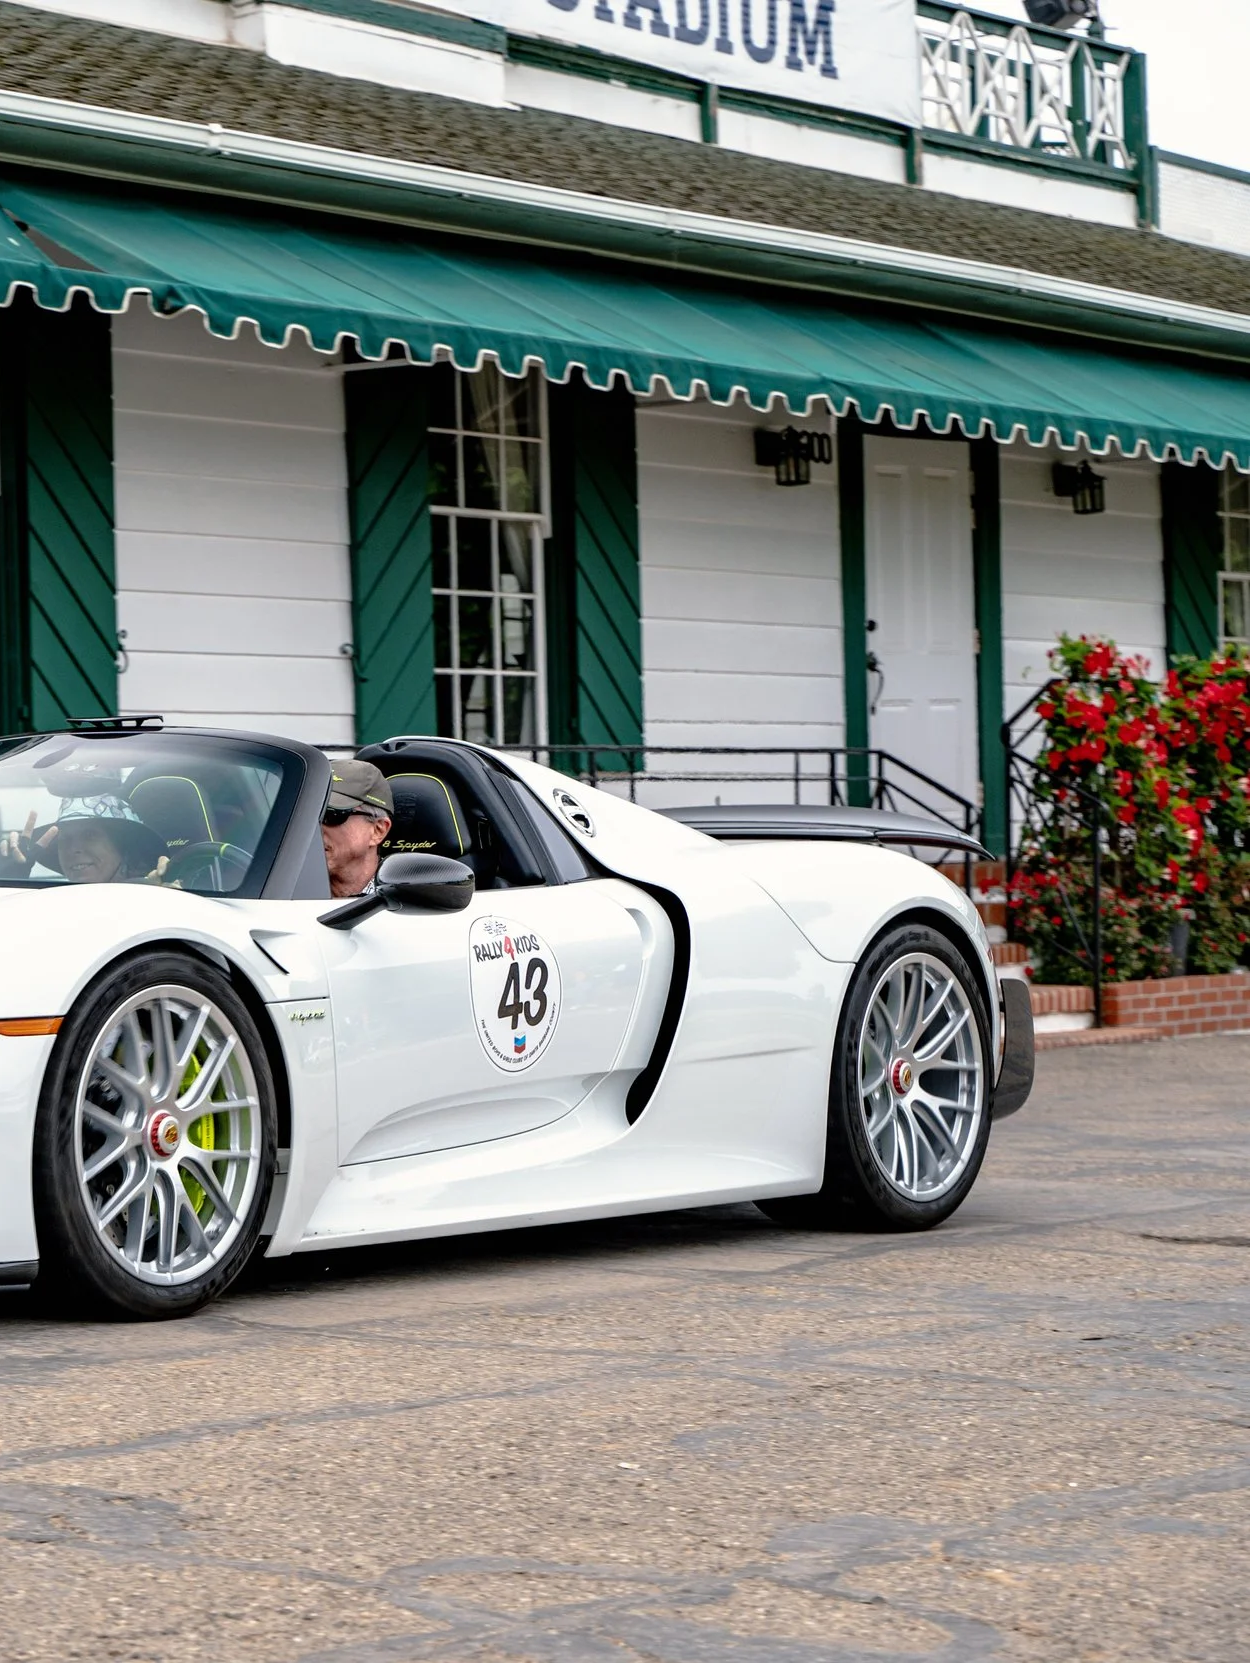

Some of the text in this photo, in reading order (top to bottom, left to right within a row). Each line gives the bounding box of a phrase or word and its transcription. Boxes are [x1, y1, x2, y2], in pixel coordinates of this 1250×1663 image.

[547, 0, 839, 80] DIUM
[166, 838, 190, 848] yder
[392, 839, 437, 852] Spyder
[473, 940, 504, 963] RALLY
[513, 934, 540, 954] KIDS
[497, 957, 549, 1030] 43
